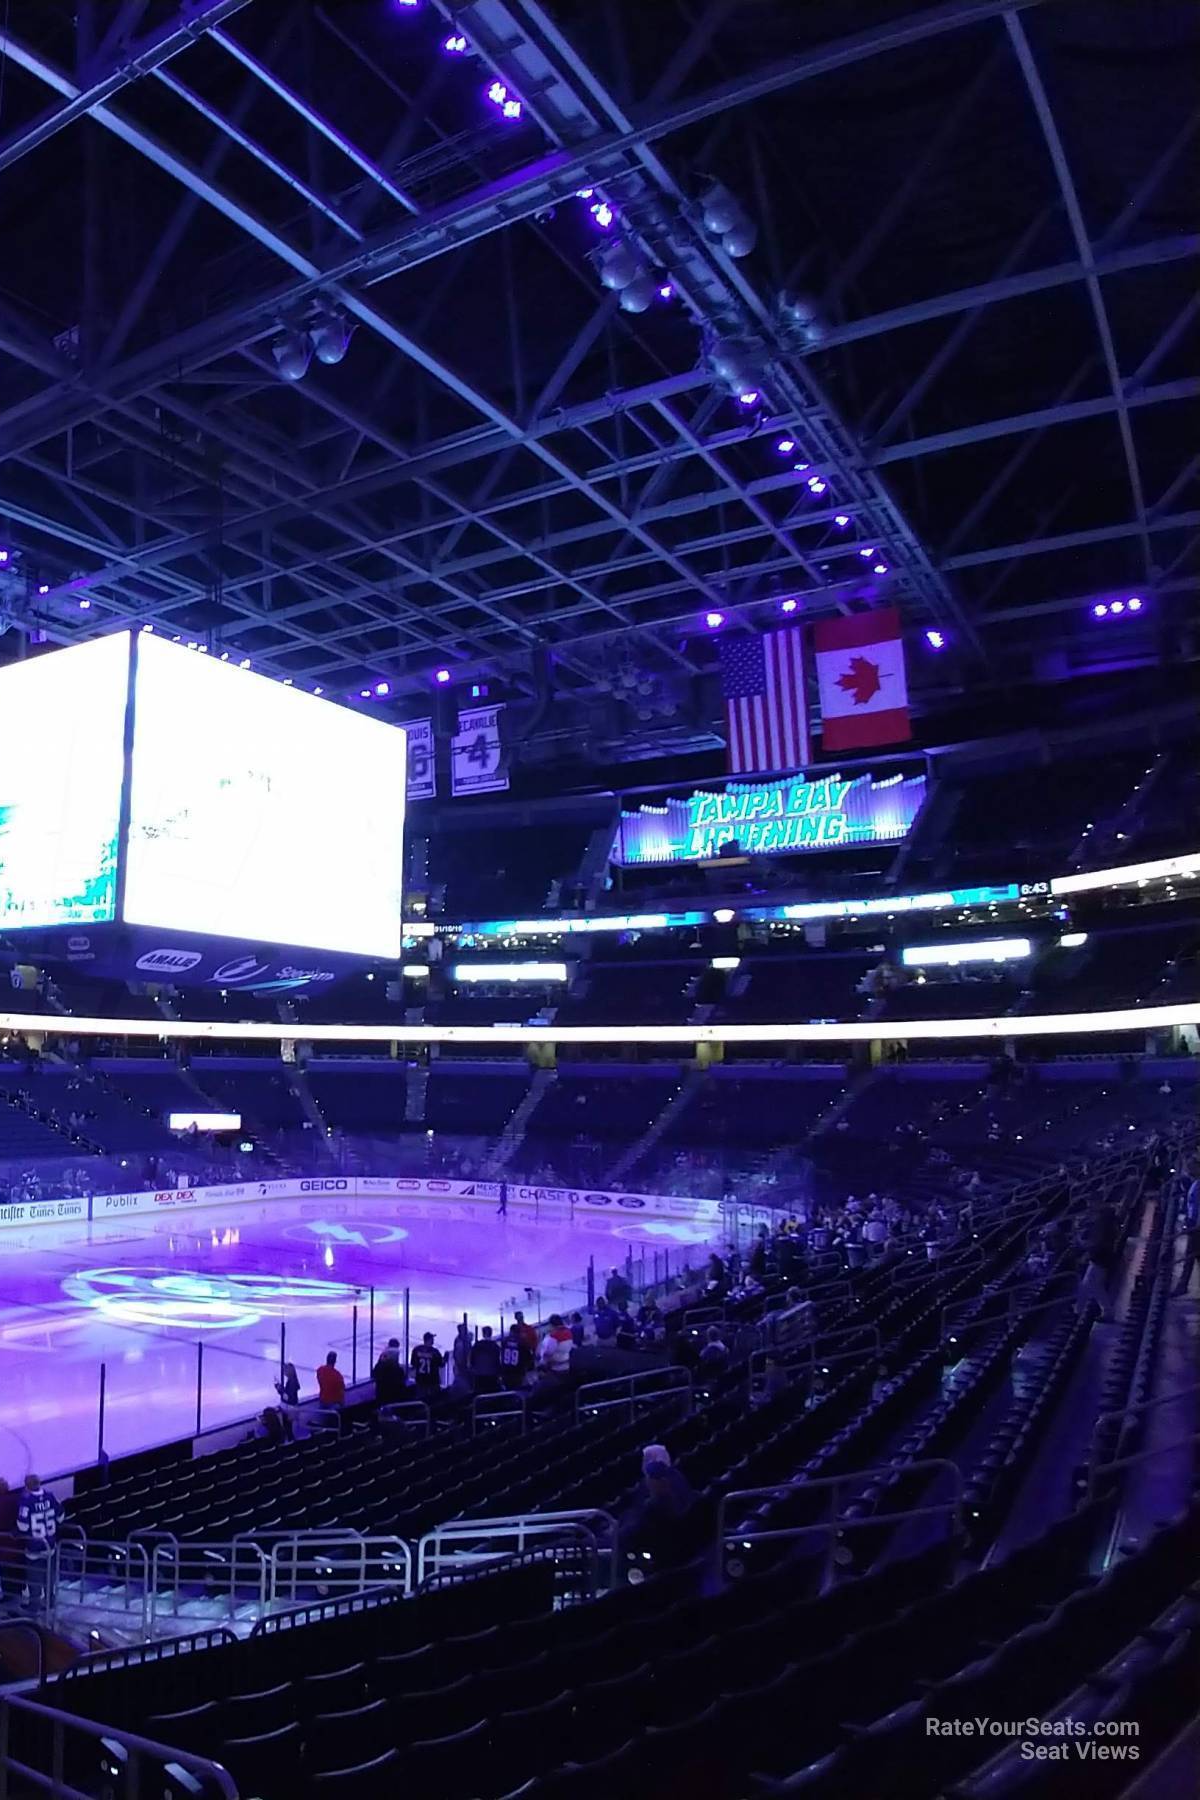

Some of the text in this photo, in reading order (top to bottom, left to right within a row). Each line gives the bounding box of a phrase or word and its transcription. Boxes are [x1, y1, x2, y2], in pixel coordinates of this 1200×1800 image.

[408, 727, 429, 741] OUIS
[468, 733, 490, 769] 4
[688, 780, 851, 828] TAMPA BAY
[1021, 882, 1048, 895] 6:43
[140, 953, 198, 968] AMALIE
[300, 1180, 348, 1191] GEICO
[154, 1192, 174, 1202] DEX
[176, 1190, 195, 1200] DEX
[519, 1188, 564, 1201] CHASE
[106, 1196, 138, 1208] Publix
